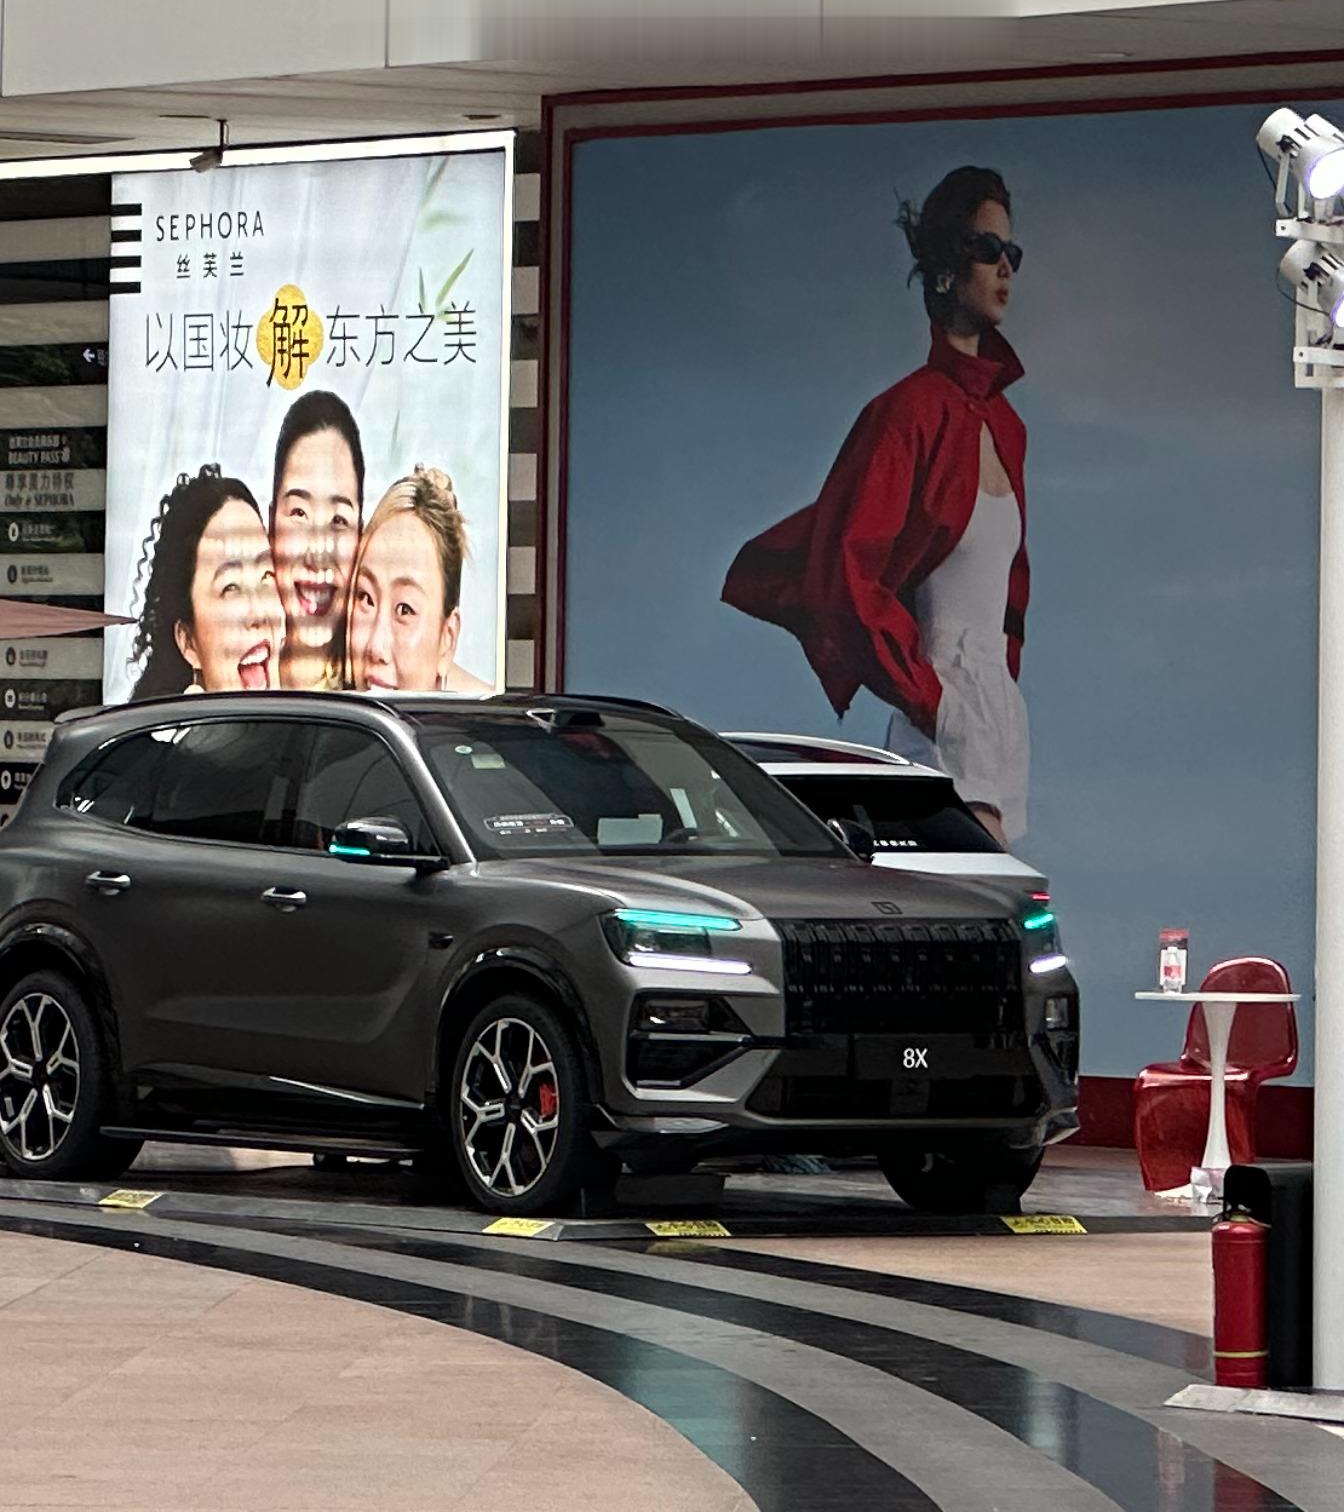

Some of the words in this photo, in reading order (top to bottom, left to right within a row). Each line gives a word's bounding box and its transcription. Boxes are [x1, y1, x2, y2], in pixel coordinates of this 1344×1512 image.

[156, 210, 265, 242] SEPHORA
[176, 251, 245, 279] 丝芙兰
[144, 298, 478, 387] 以国妆解东方之美
[903, 1047, 929, 1069] 8X
